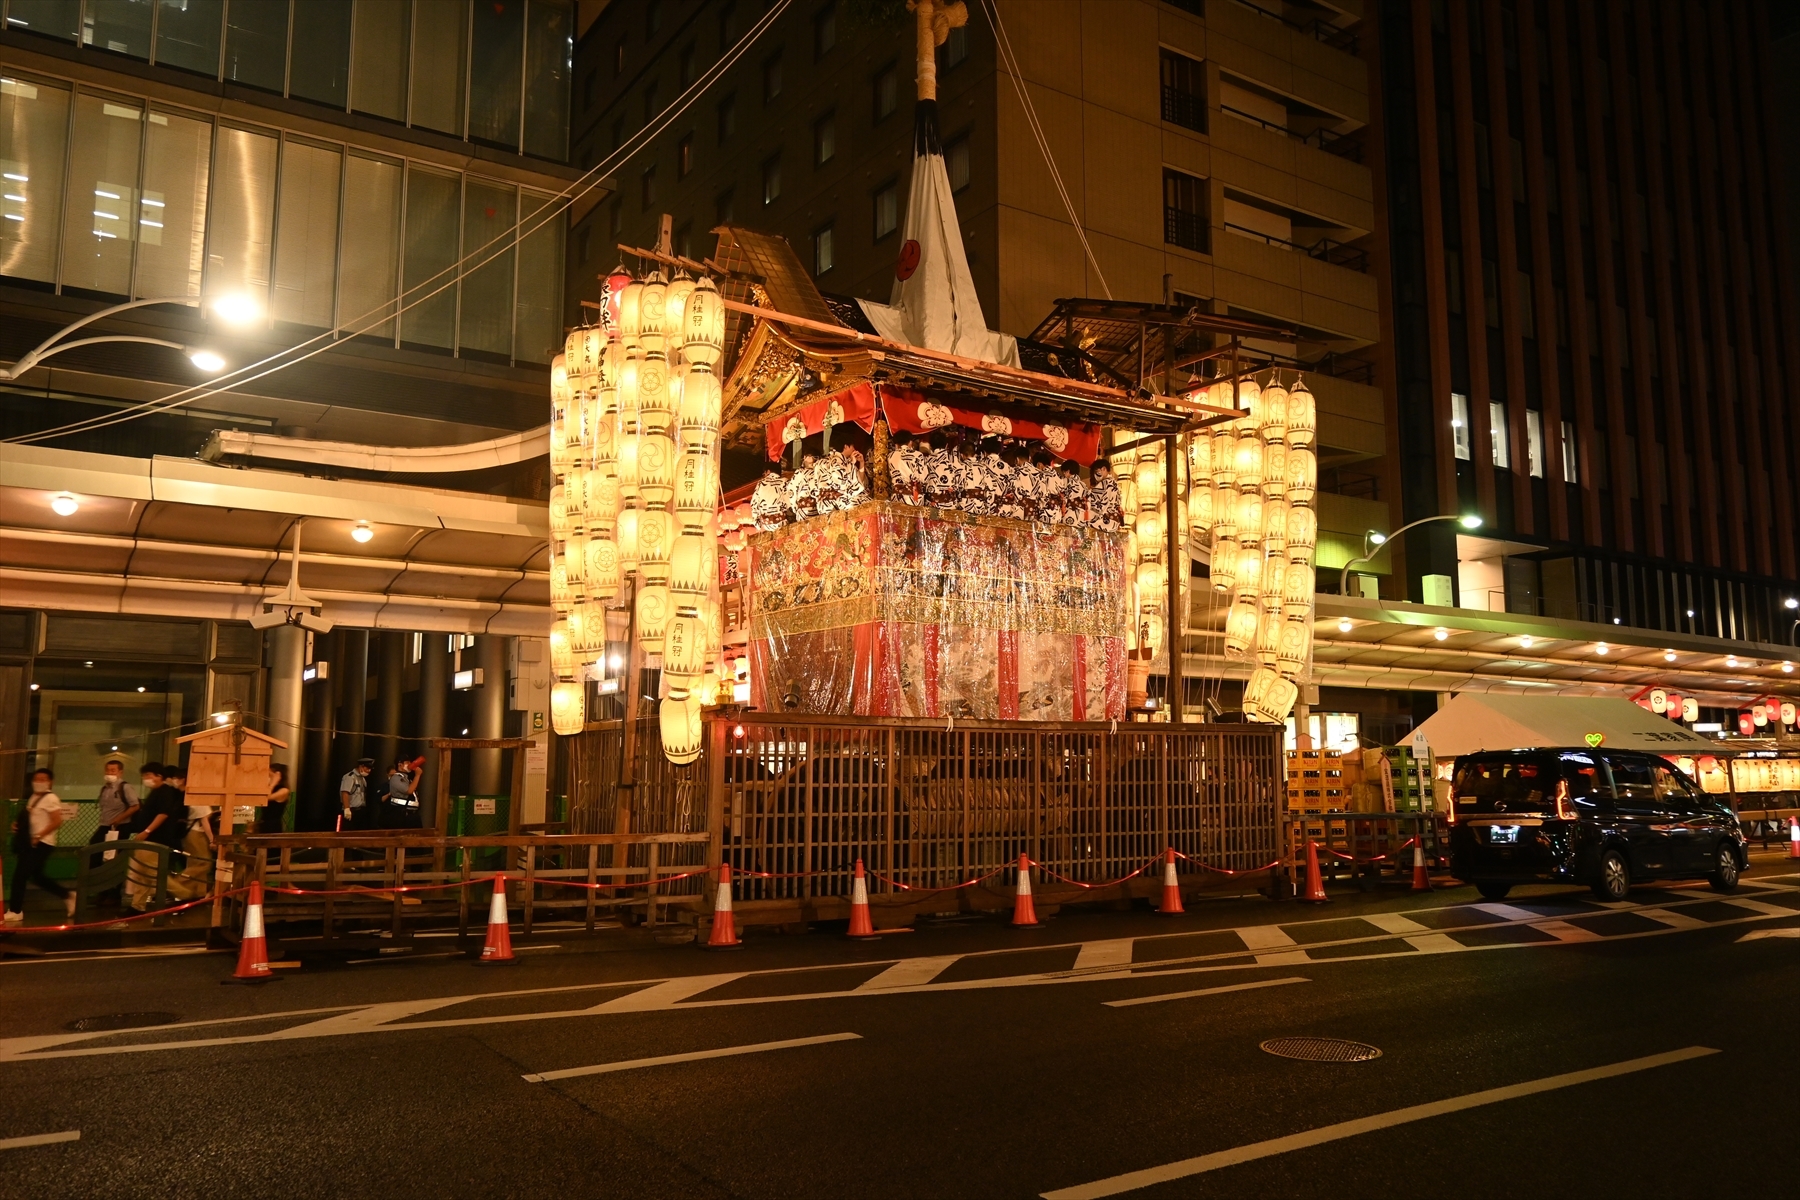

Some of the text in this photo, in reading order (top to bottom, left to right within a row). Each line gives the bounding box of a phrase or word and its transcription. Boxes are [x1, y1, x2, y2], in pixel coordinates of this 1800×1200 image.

[692, 294, 704, 327] 月桂冠
[684, 458, 695, 492] 月桂冠
[672, 622, 684, 657] 月桂冠
